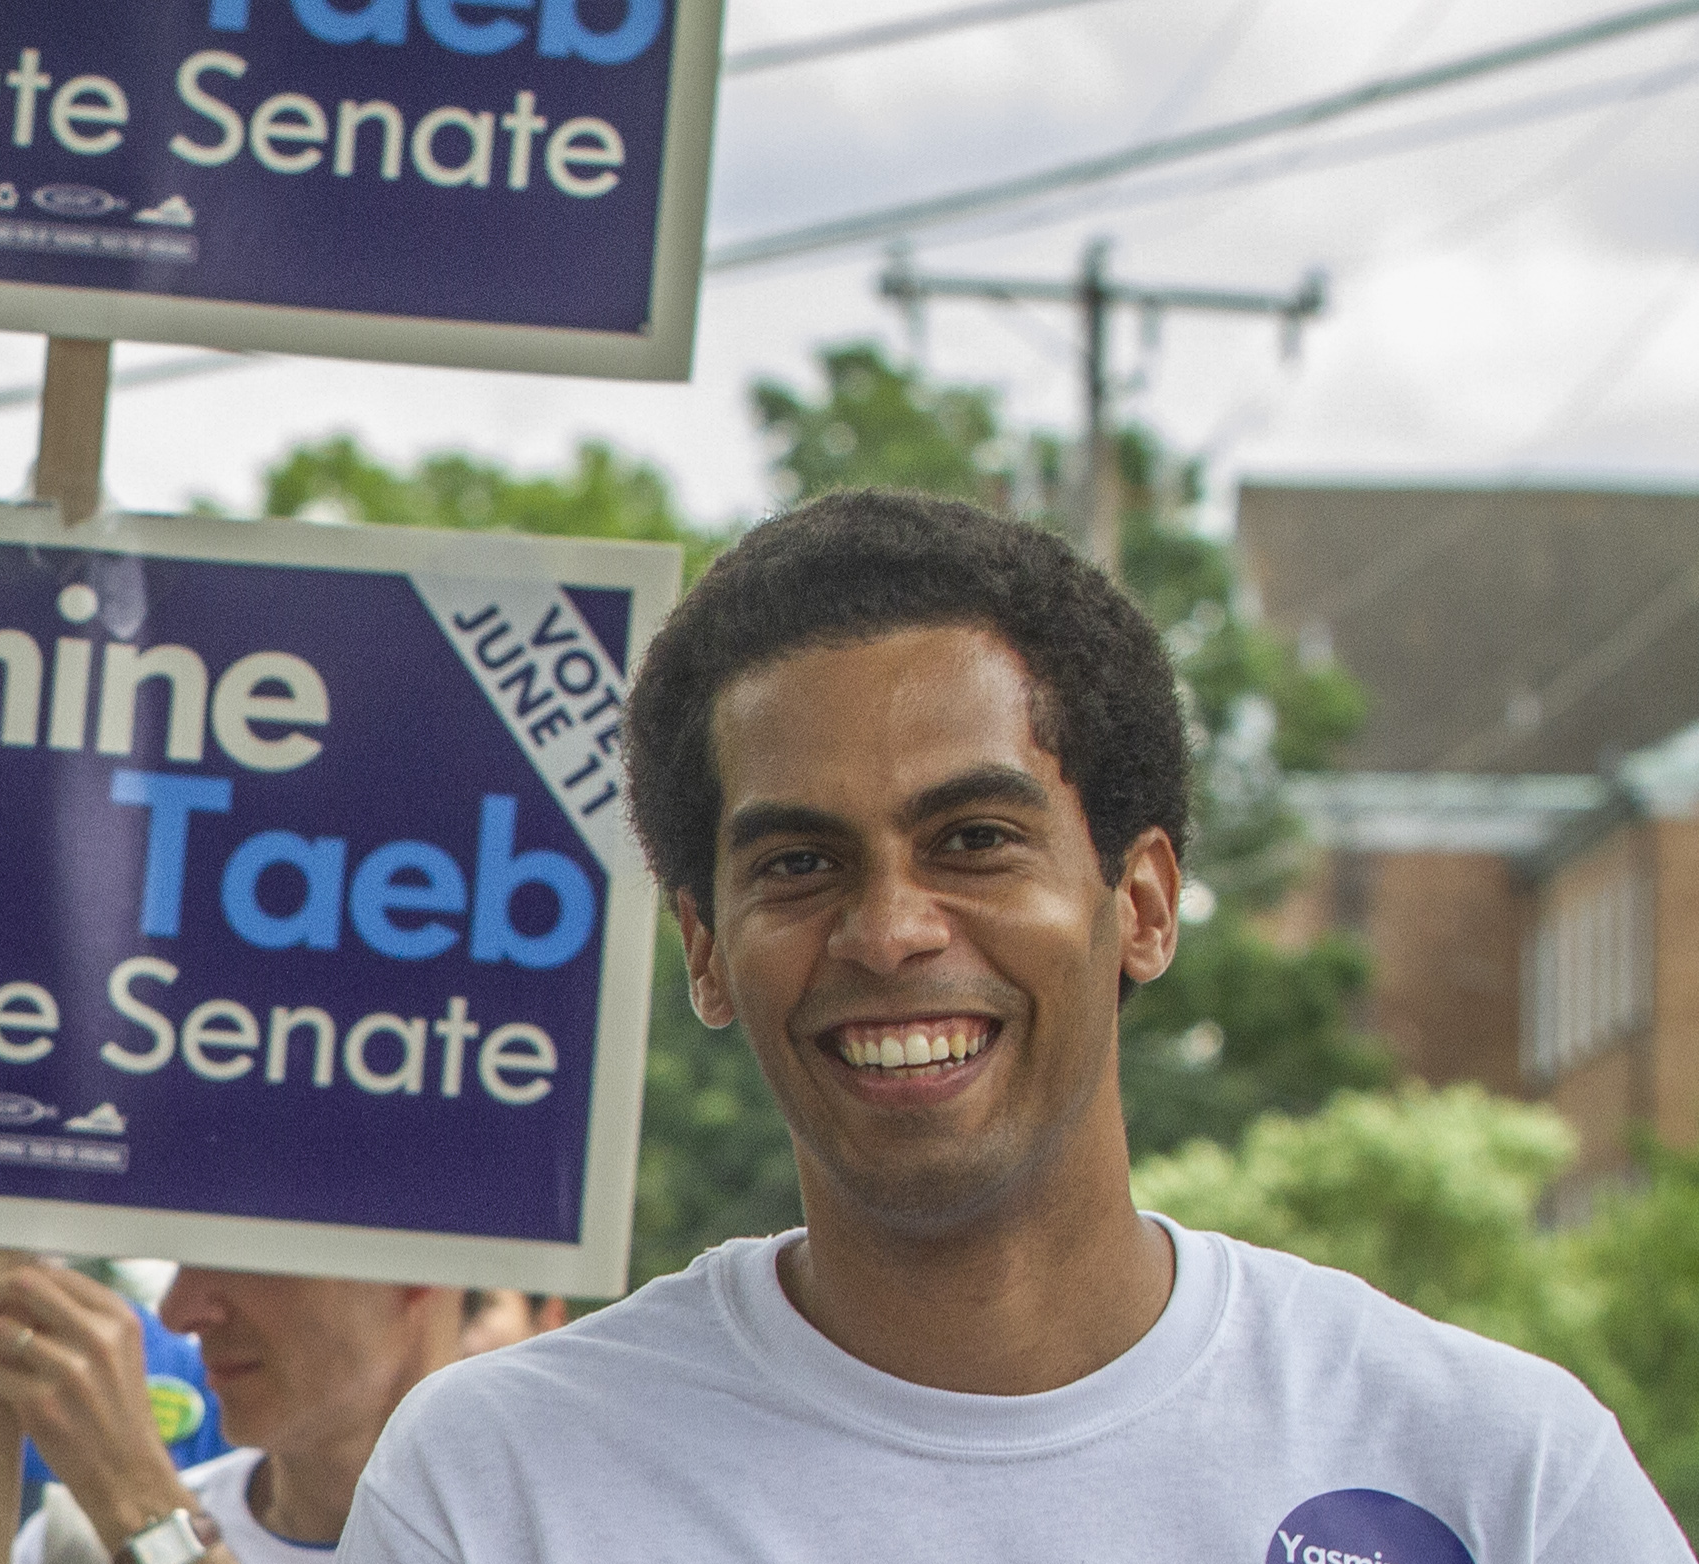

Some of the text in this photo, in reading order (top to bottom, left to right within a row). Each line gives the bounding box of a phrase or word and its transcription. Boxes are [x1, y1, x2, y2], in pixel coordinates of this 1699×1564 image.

[169, 49, 626, 199] Senate
[453, 603, 619, 817] JUNE 11
[110, 769, 597, 970] Taeb
[100, 955, 559, 1105] Senate
